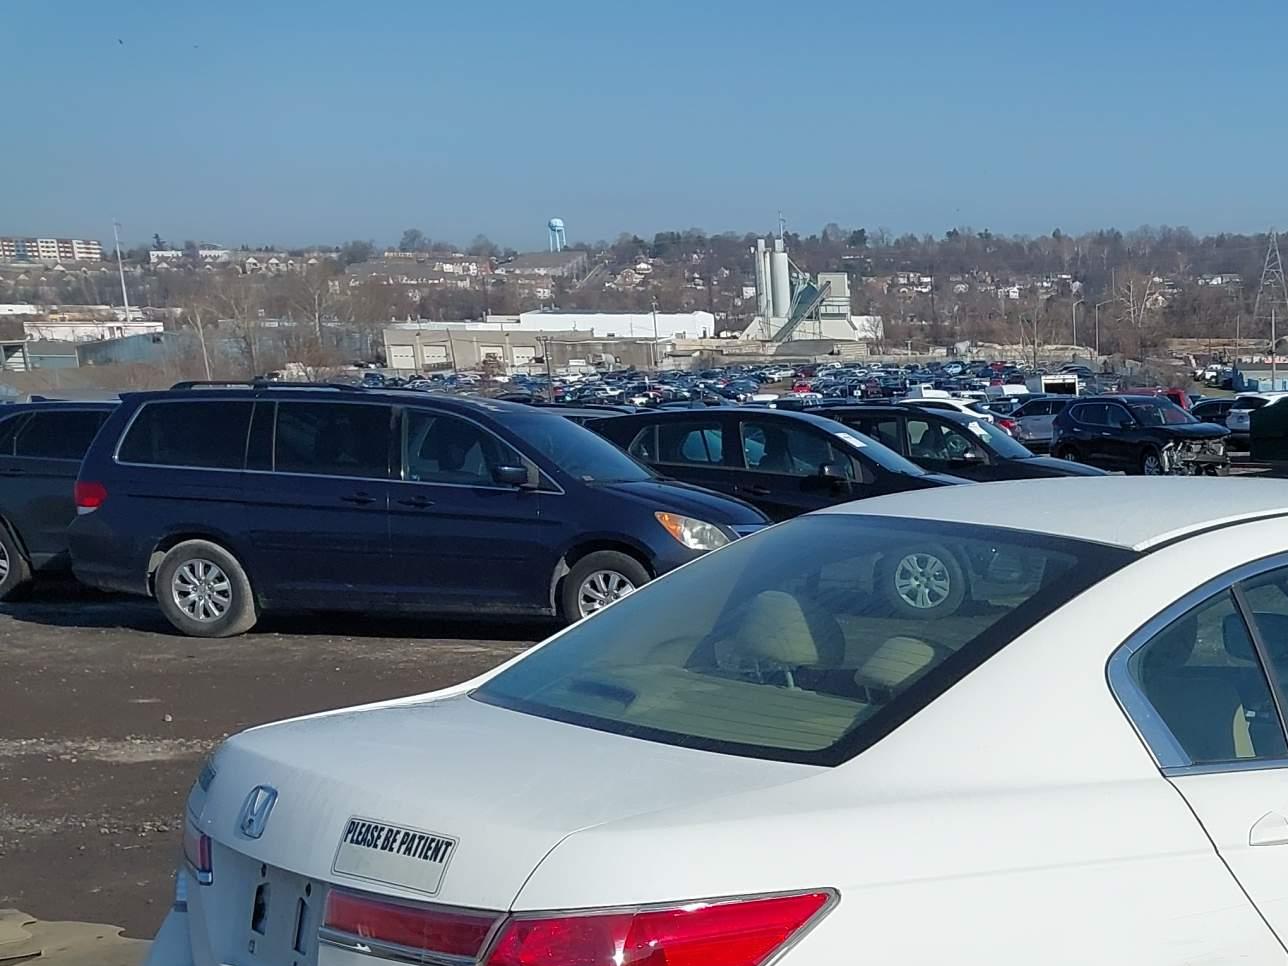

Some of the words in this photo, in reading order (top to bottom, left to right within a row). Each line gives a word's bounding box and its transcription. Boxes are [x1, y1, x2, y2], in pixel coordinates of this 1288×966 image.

[344, 821, 383, 849] PLEASE
[381, 829, 401, 852] BE
[397, 832, 452, 863] PATIENT
